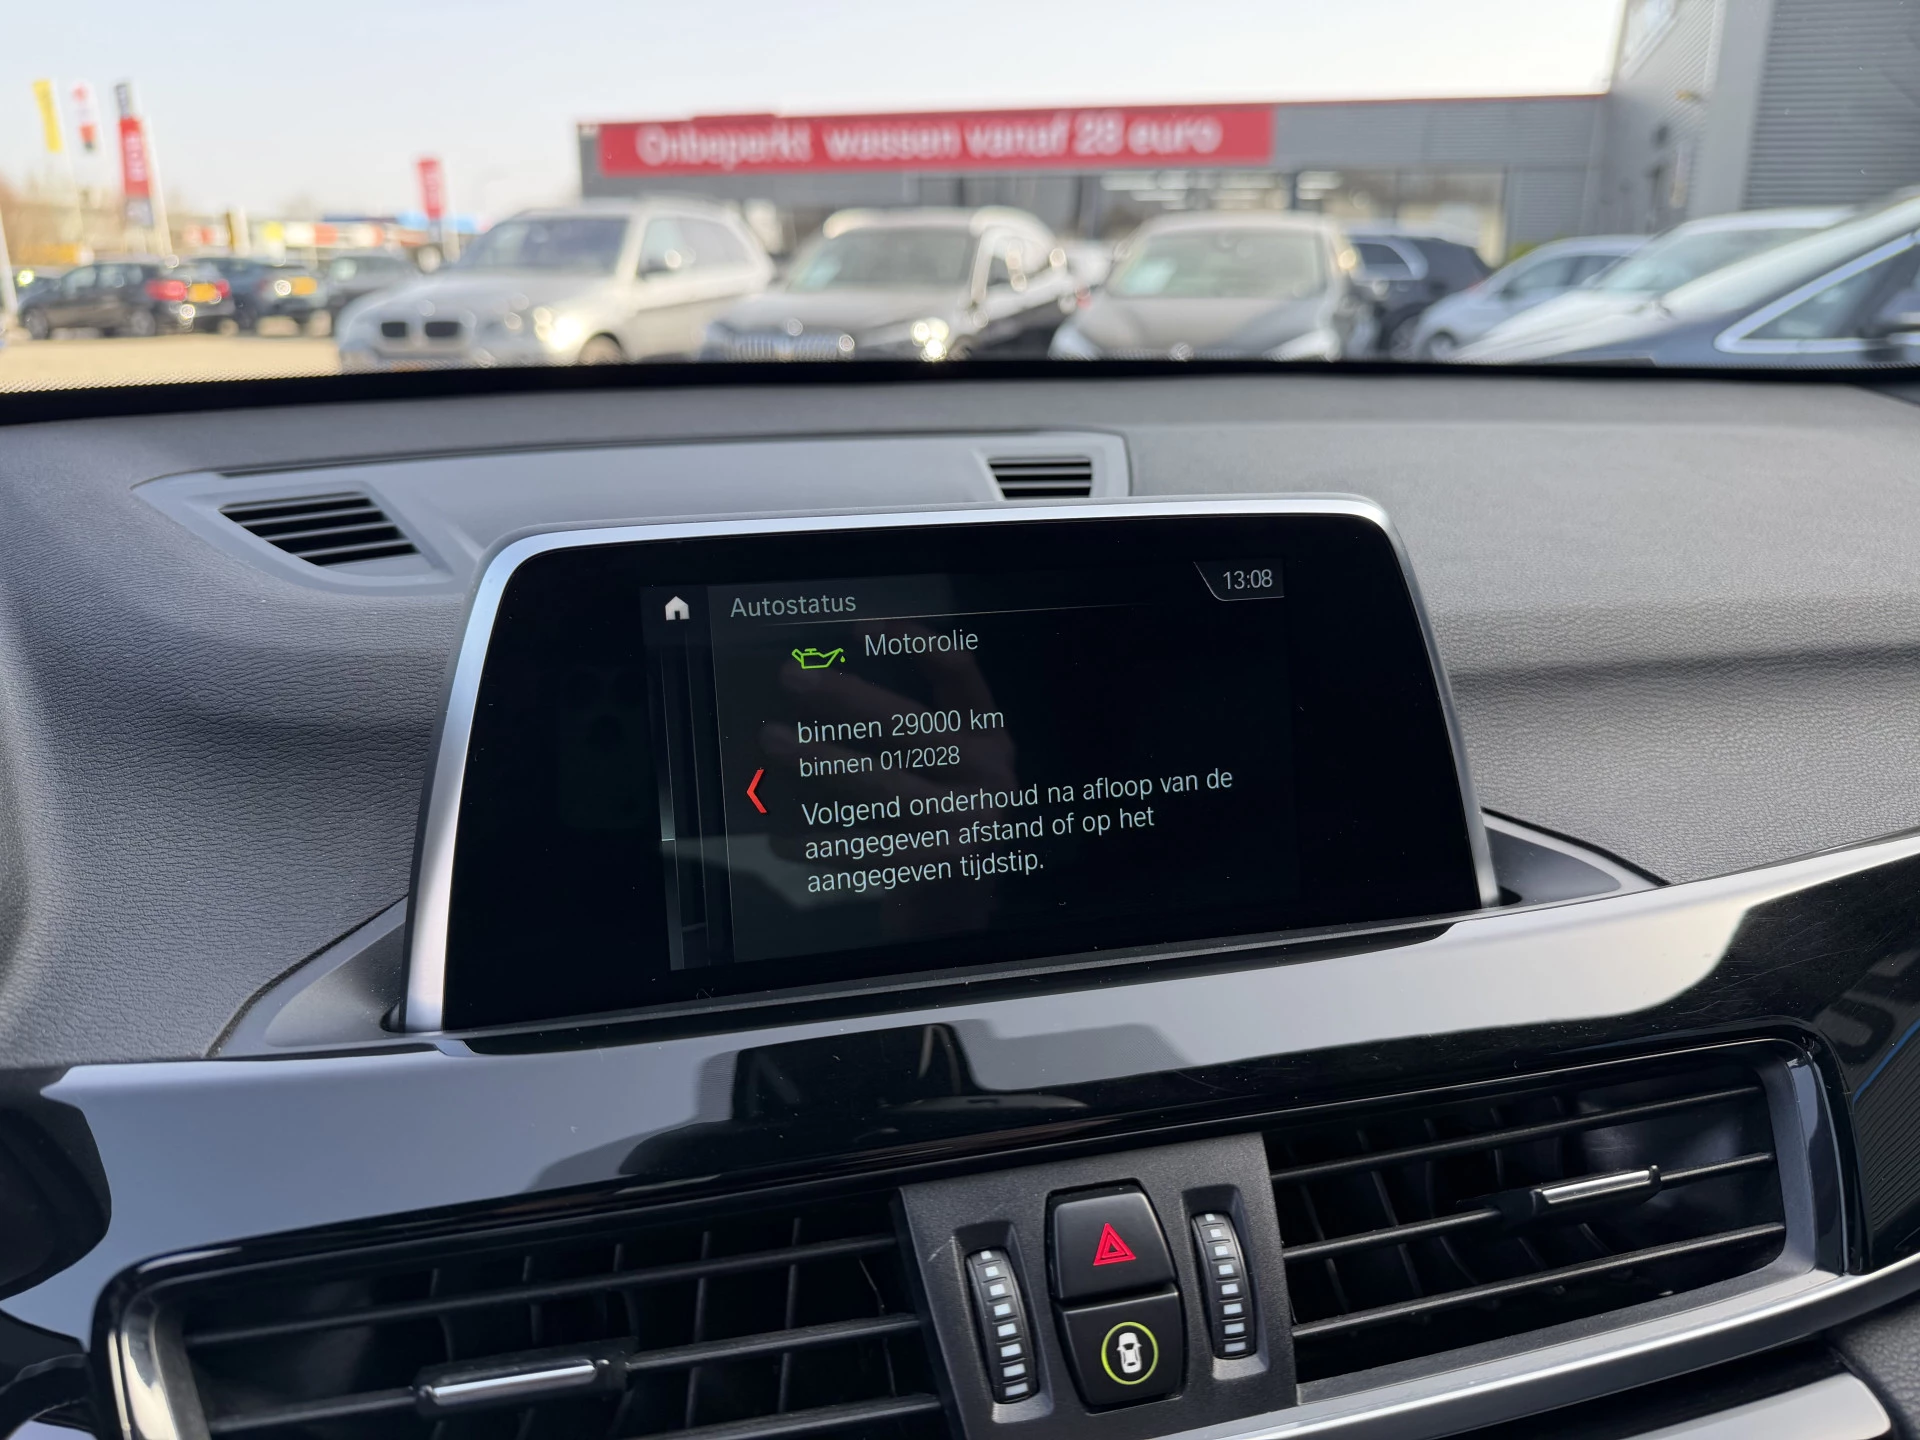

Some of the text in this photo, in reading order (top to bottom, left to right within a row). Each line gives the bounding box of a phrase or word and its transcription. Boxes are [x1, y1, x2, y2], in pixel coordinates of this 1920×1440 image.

[636, 112, 1222, 168] Onbeperkt wassen vanaf 28 euro
[1223, 569, 1273, 590] 13:08
[730, 594, 856, 618] Autostatus
[864, 628, 978, 657] Motorolie
[797, 708, 1004, 744] binnen 29000 km
[799, 745, 961, 777] binnen 01/2028
[801, 767, 1233, 828] Volgend onderhoud na afloop van de
[805, 806, 1155, 860] aangegeven afstand of op het
[807, 849, 1044, 893] aangegeven tijdstip.
